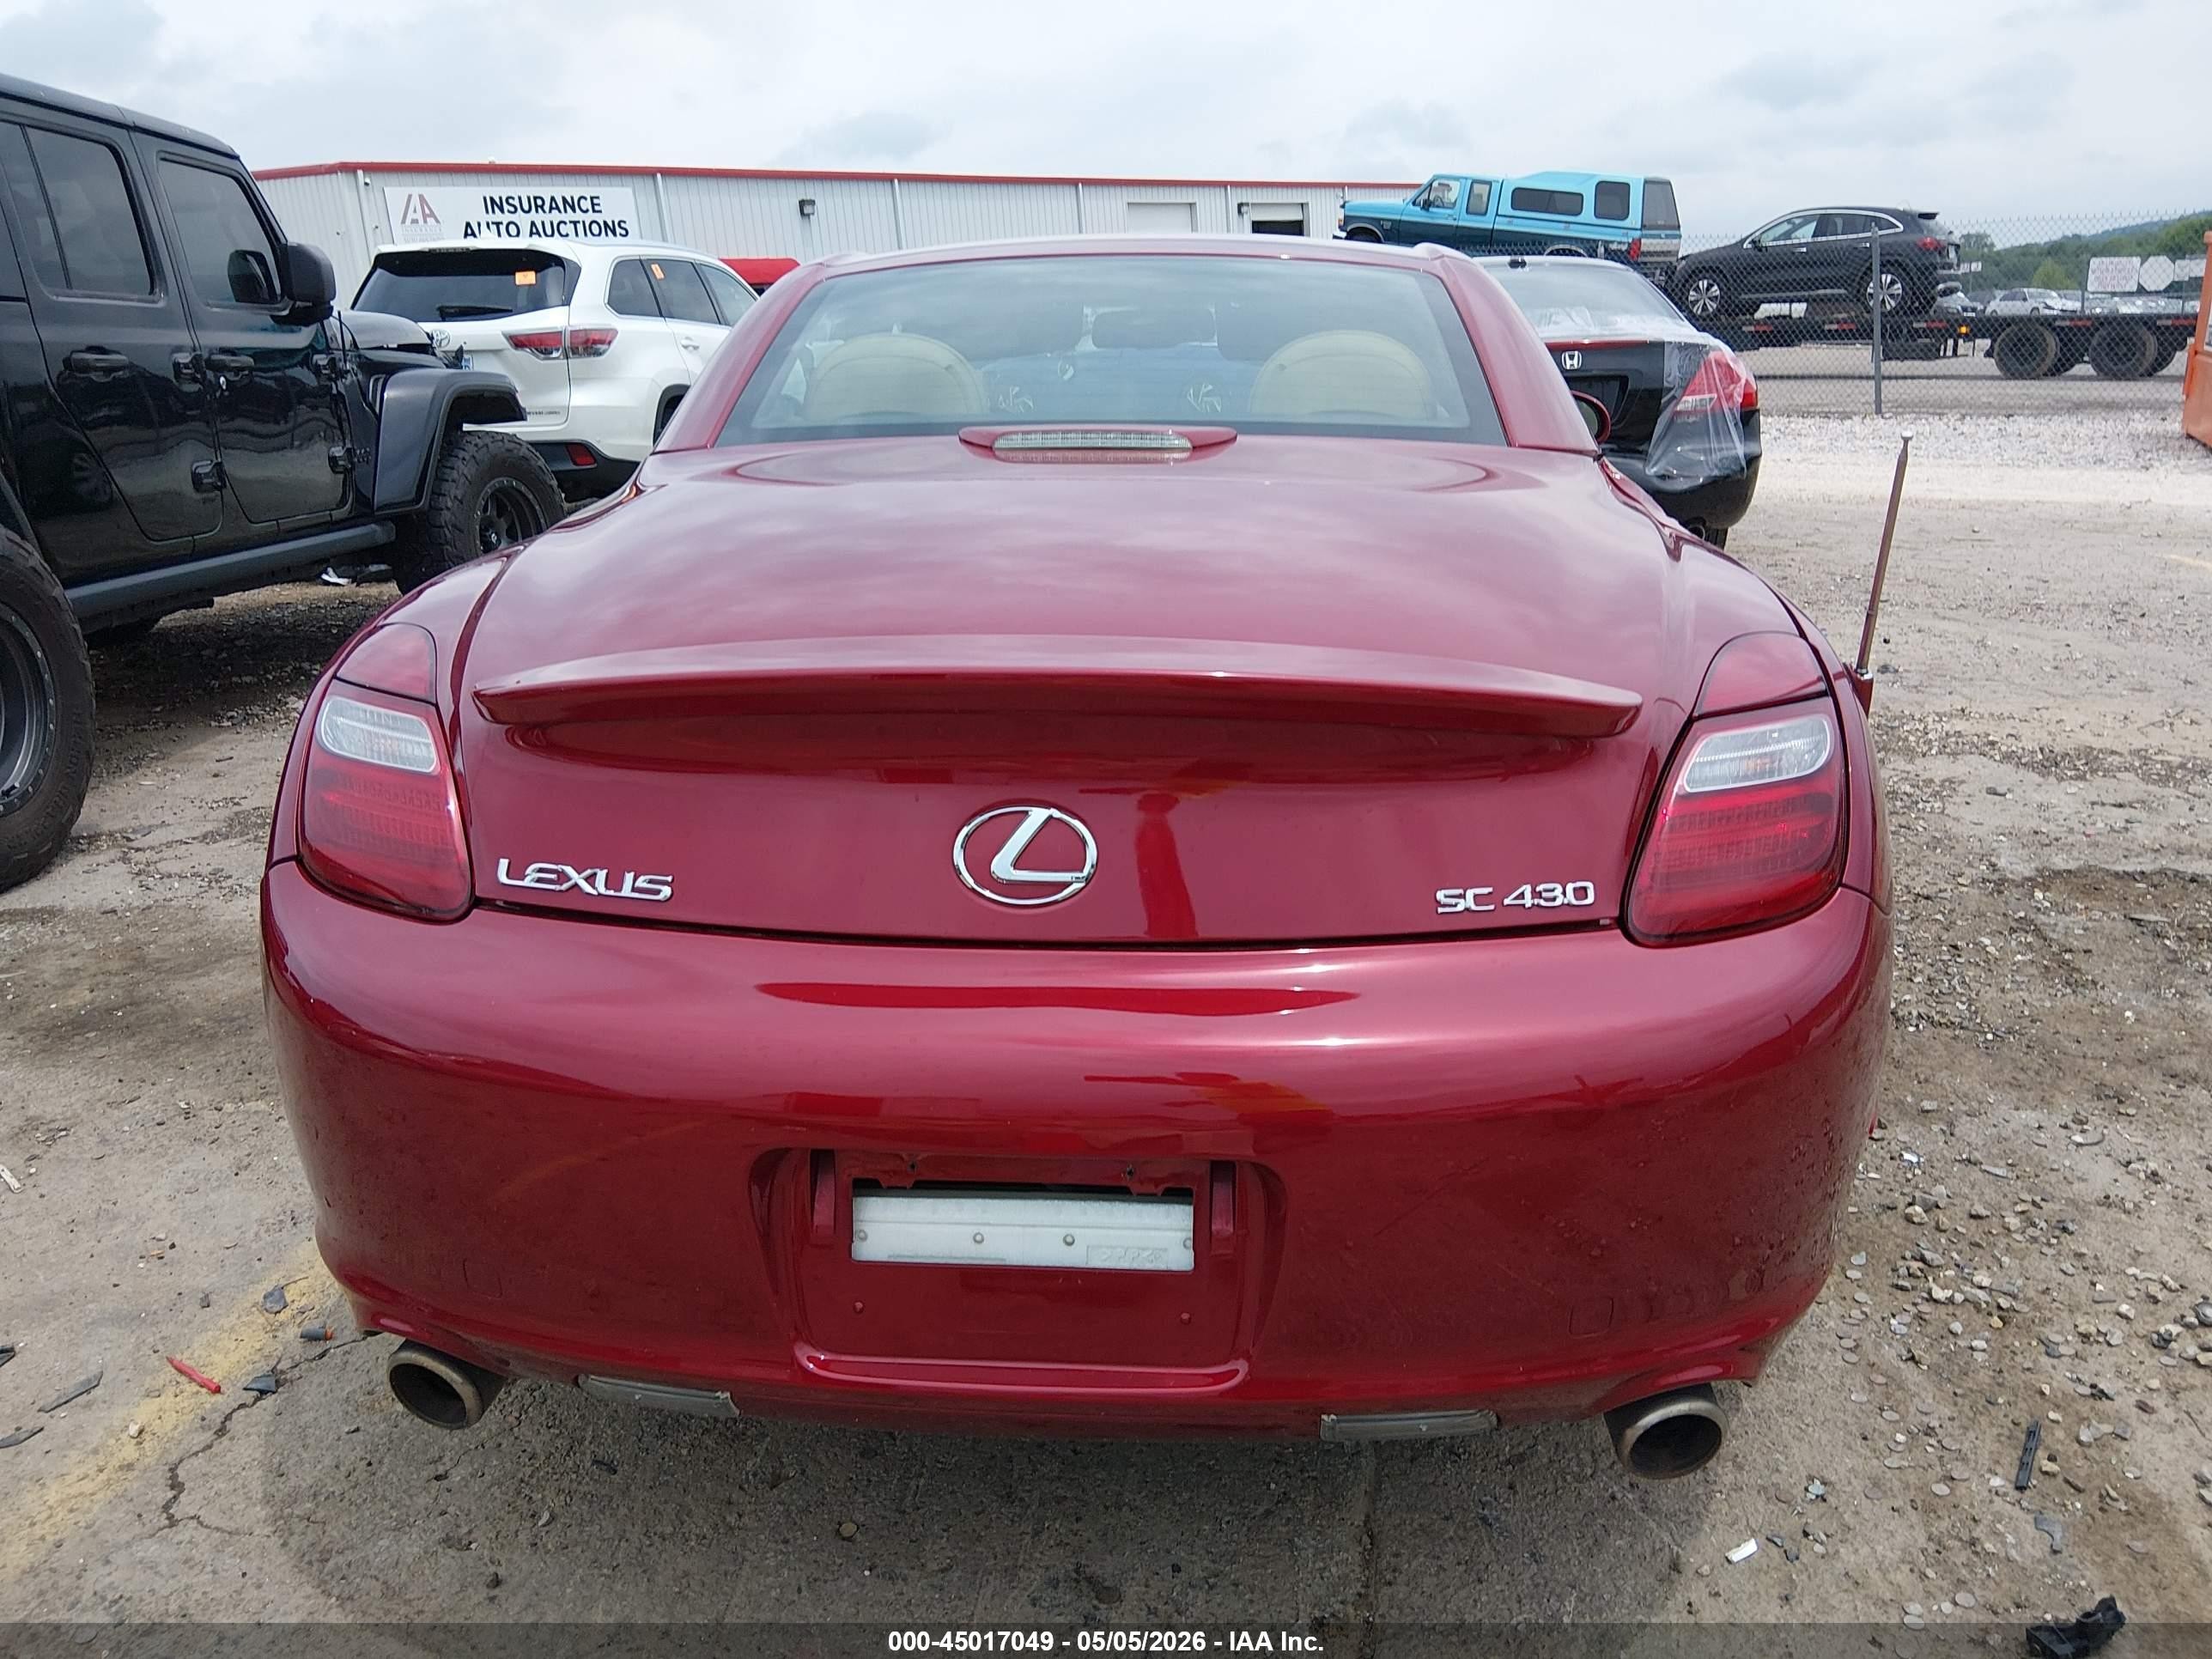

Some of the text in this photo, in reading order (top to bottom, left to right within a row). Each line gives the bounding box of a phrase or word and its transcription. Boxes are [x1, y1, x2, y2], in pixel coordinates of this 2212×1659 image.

[483, 195, 604, 215] INSURANCE
[528, 219, 629, 238] AUCTIONS
[497, 858, 674, 902] LEXUS
[1436, 881, 1595, 914] SC 430
